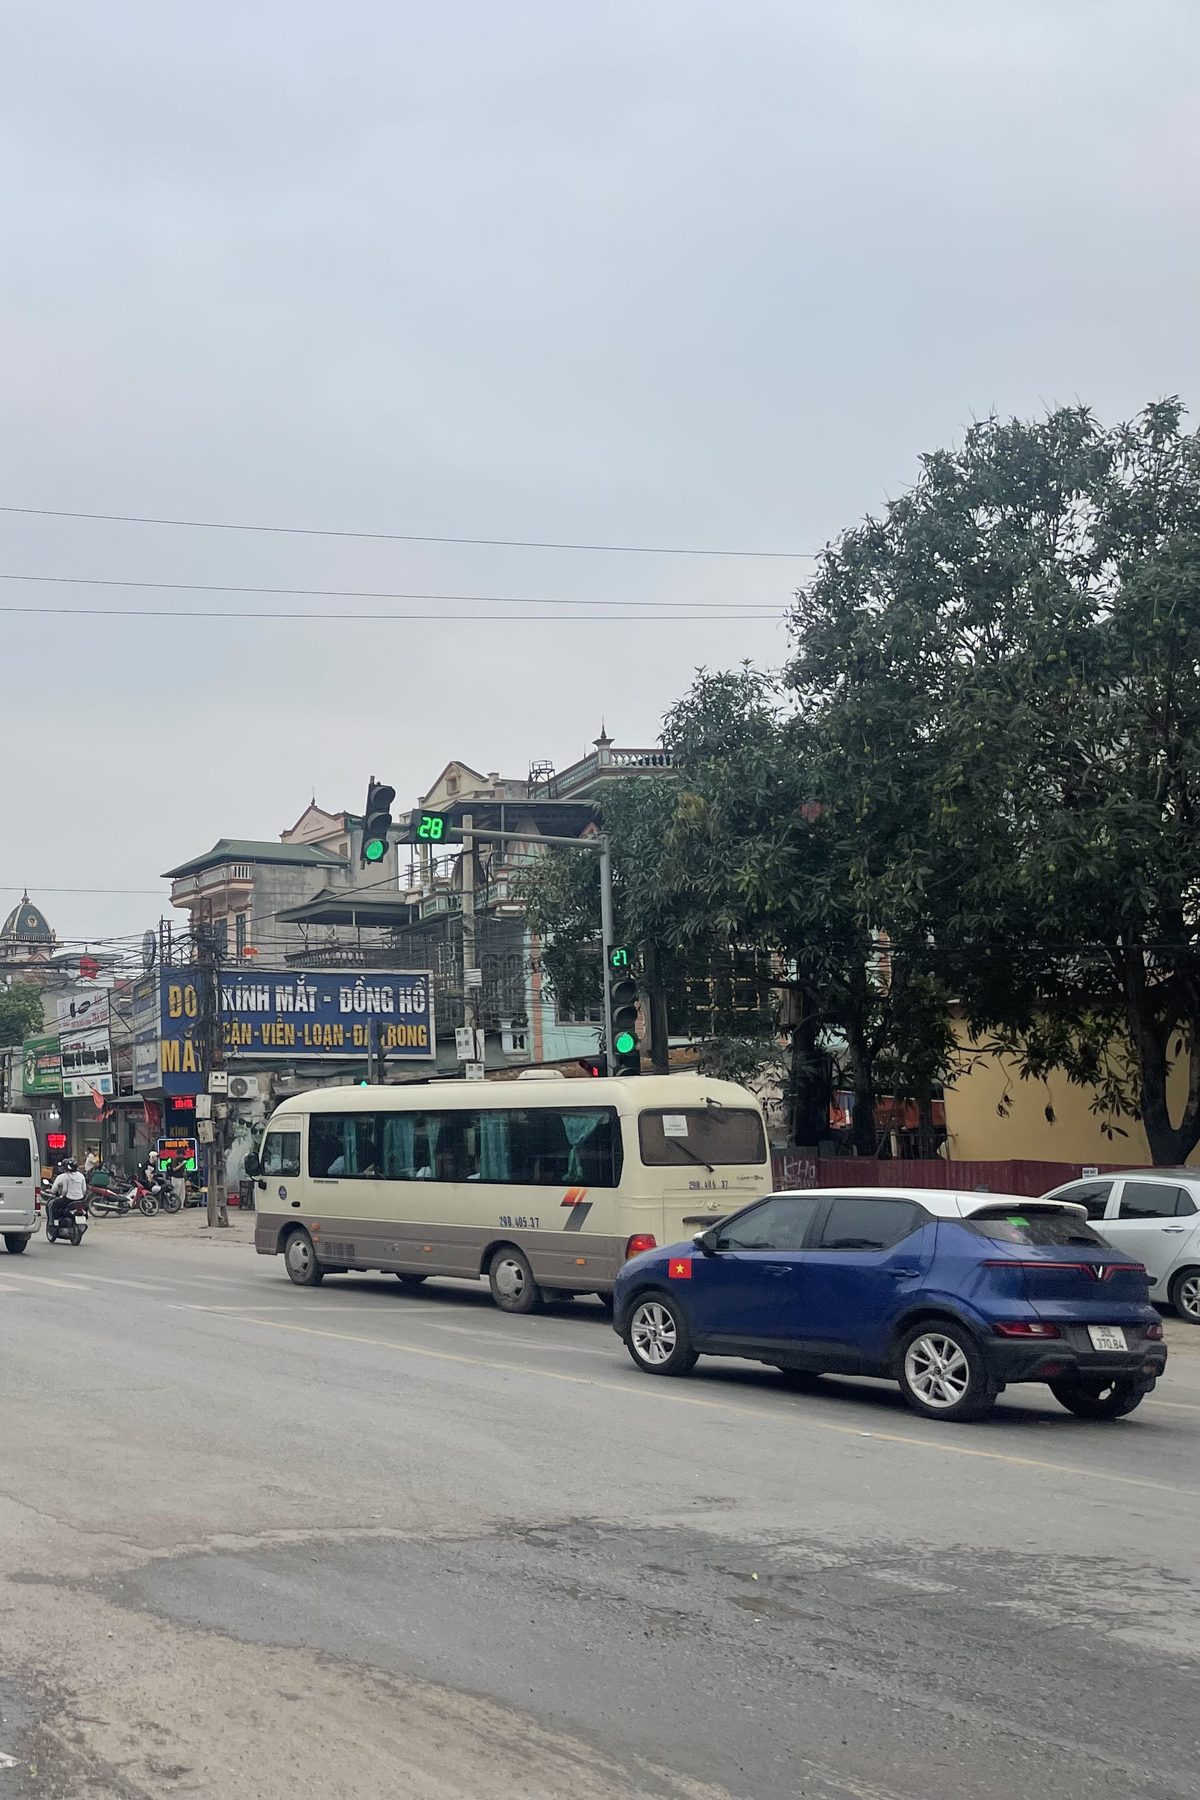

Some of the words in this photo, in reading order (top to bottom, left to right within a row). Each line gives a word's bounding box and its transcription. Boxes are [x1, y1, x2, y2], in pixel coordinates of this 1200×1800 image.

[418, 816, 444, 838] 28
[613, 949, 628, 967] 27
[222, 975, 270, 1011] KÍNH
[275, 973, 318, 1012] MẮT
[339, 975, 394, 1013] ĐỒNG
[399, 976, 427, 1014] HỒ
[261, 1014, 295, 1046] VIỄN
[304, 1023, 344, 1051] LOẠN
[381, 1017, 428, 1047] RÒNG
